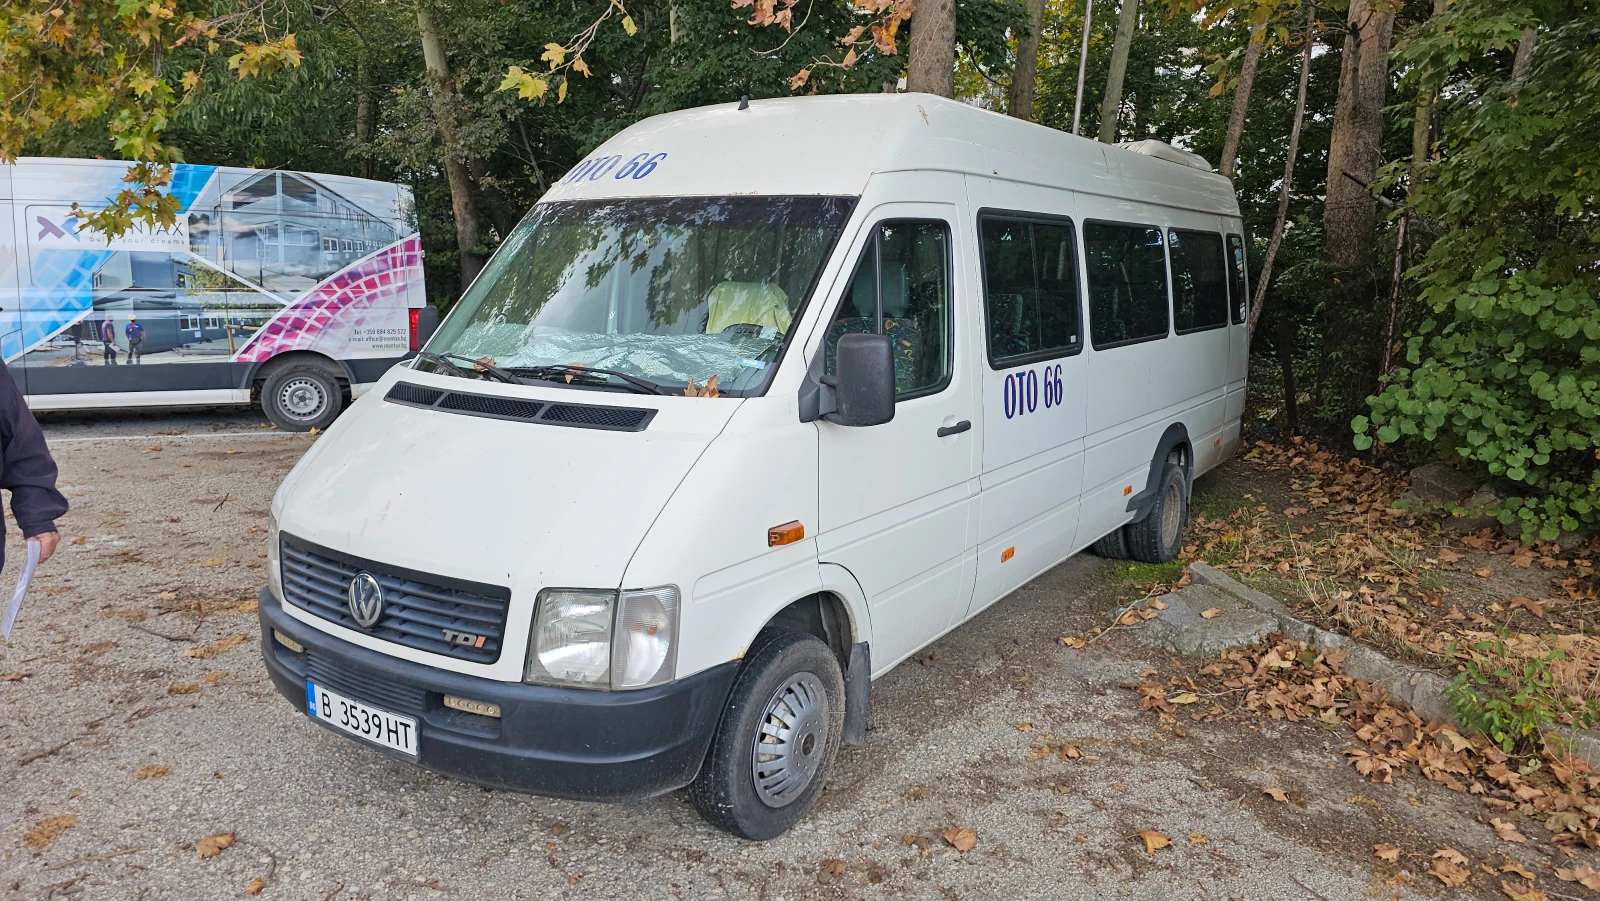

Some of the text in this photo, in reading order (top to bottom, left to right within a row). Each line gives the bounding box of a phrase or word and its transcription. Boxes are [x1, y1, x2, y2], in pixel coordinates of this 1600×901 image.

[614, 152, 668, 180] 66
[1043, 363, 1063, 409] 66
[321, 692, 332, 719] B
